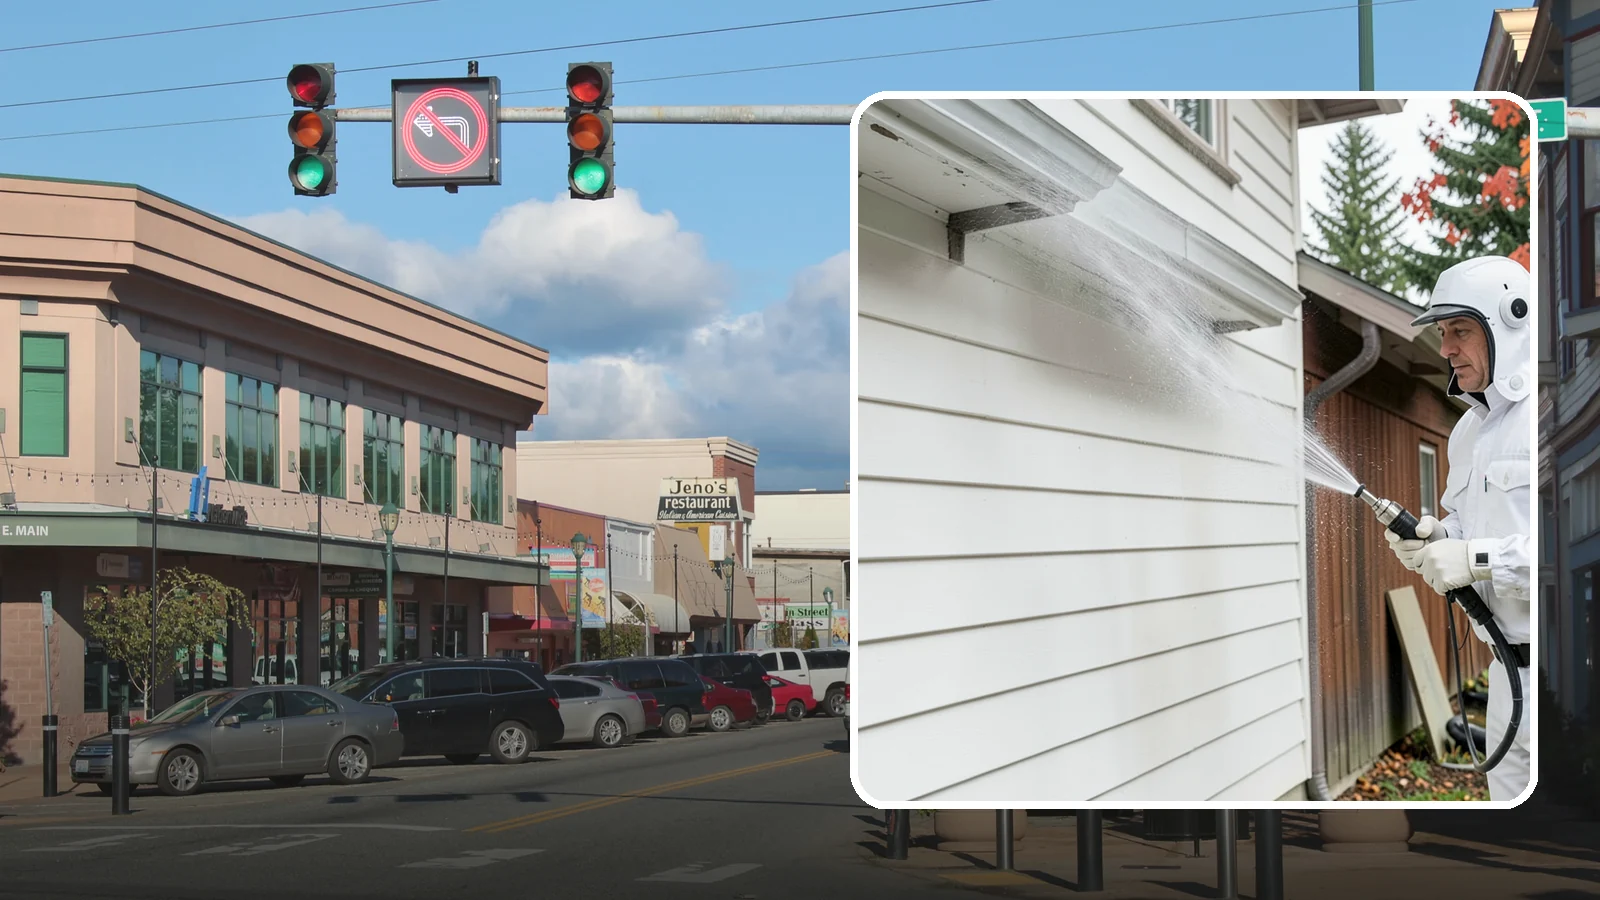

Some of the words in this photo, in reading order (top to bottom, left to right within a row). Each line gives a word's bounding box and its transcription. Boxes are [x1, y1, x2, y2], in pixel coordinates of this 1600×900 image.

[669, 480, 727, 494] Jeno's
[665, 496, 731, 509] restaurant
[659, 510, 682, 519] Italian
[686, 510, 715, 519] American
[715, 510, 738, 519] Cuisine
[2, 525, 13, 536] E.
[15, 525, 49, 536] MAIN
[785, 607, 795, 616] in
[797, 607, 828, 616] Street
[791, 619, 823, 627] lass
